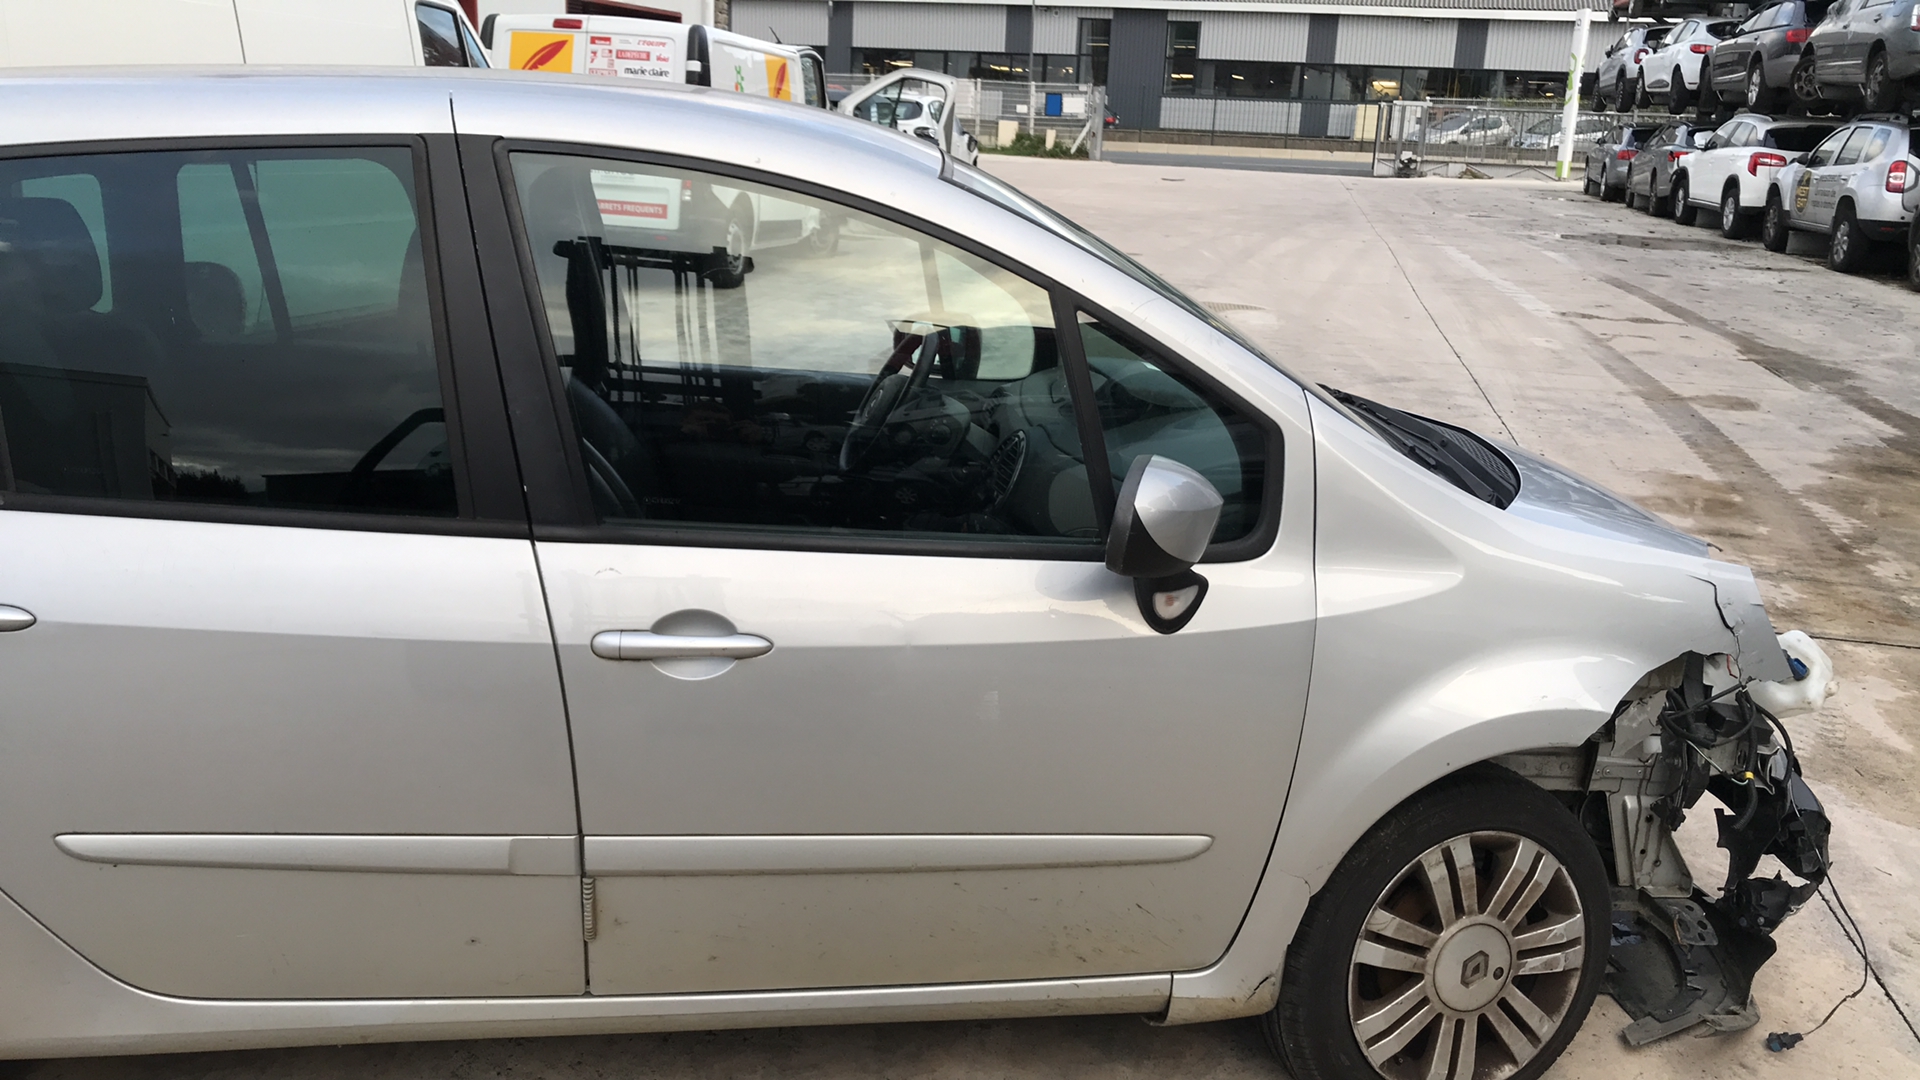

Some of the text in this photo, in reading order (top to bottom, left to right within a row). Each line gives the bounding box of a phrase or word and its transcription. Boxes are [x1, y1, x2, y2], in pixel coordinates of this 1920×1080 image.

[624, 66, 670, 77] marie claire
[623, 204, 663, 215] FREQUENTS
